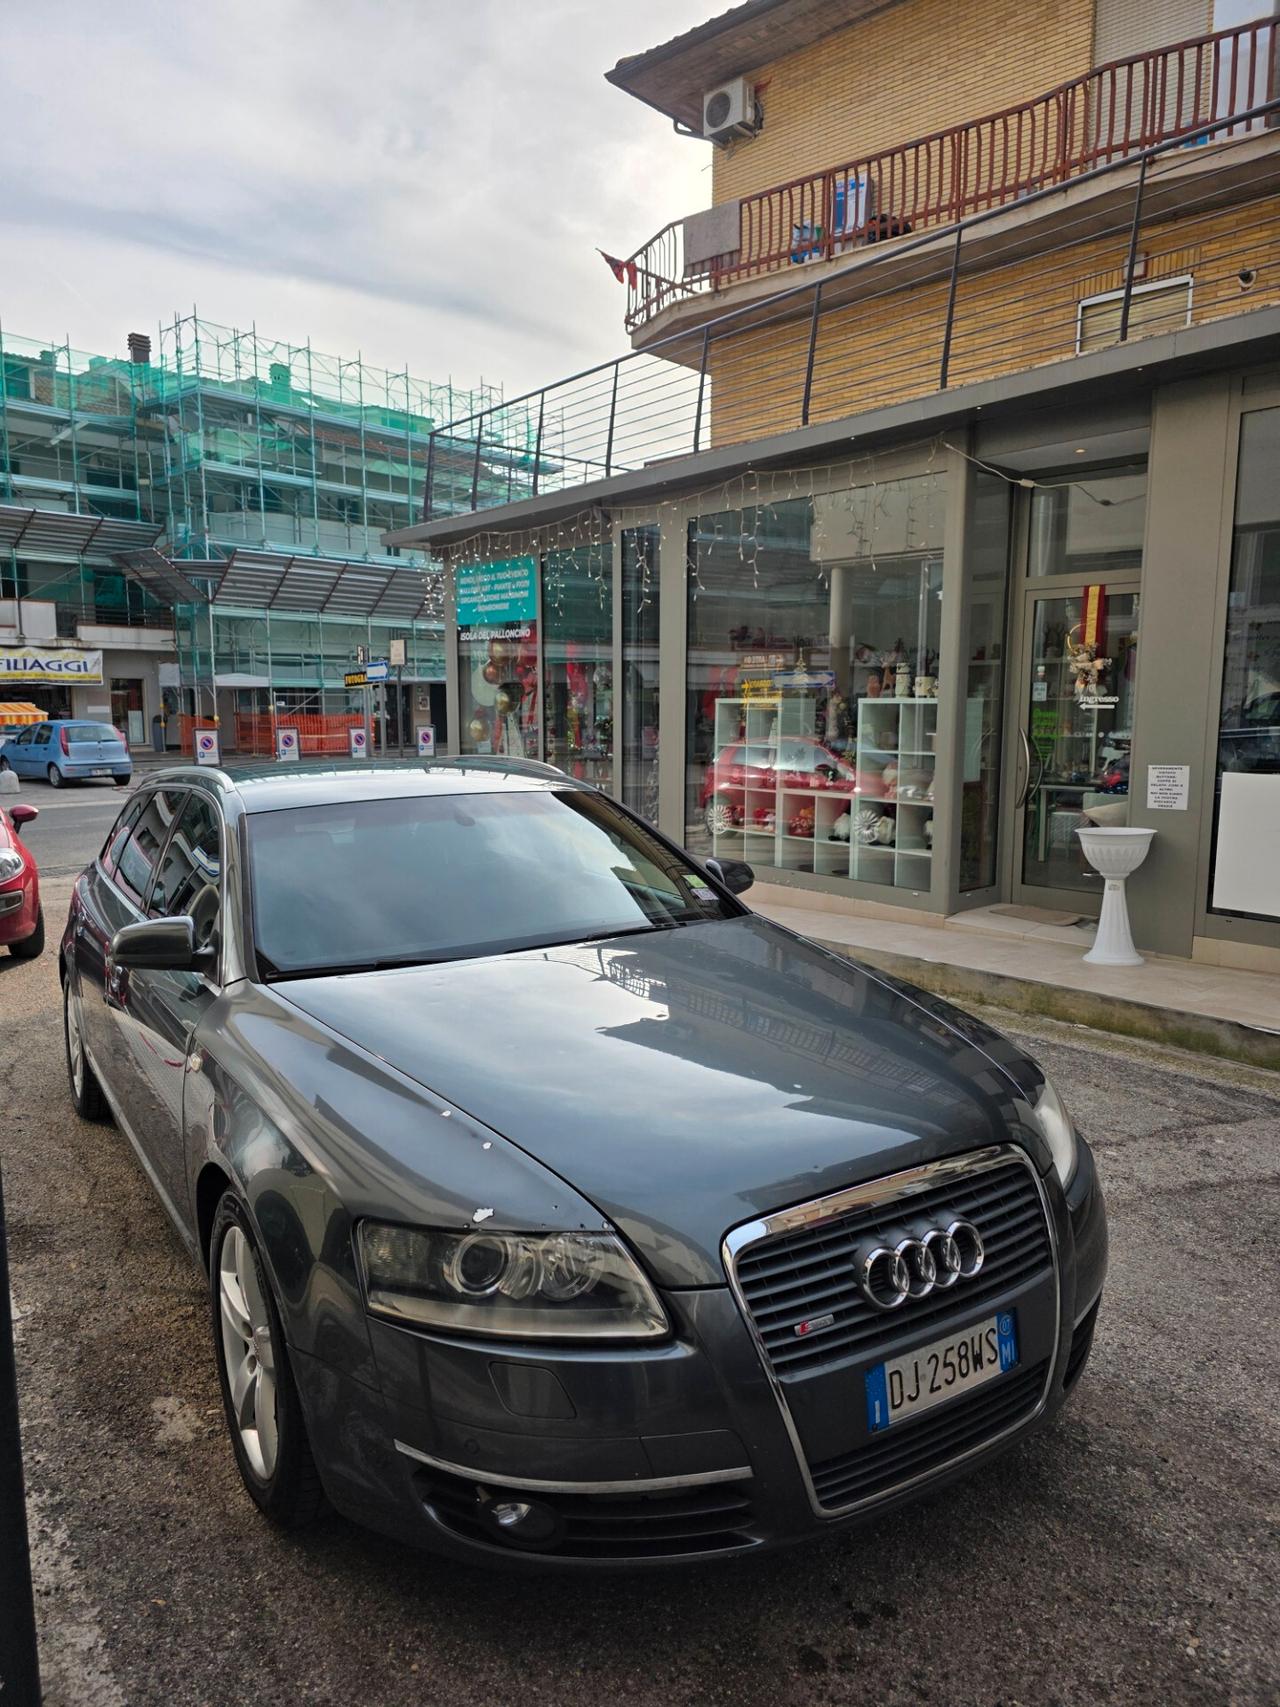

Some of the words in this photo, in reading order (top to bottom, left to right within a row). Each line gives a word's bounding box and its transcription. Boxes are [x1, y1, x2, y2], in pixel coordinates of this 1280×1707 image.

[460, 631, 478, 641] ISOLA
[479, 630, 490, 640] DEL
[490, 628, 531, 640] PALLONCINO
[1002, 1340, 1015, 1365] MI
